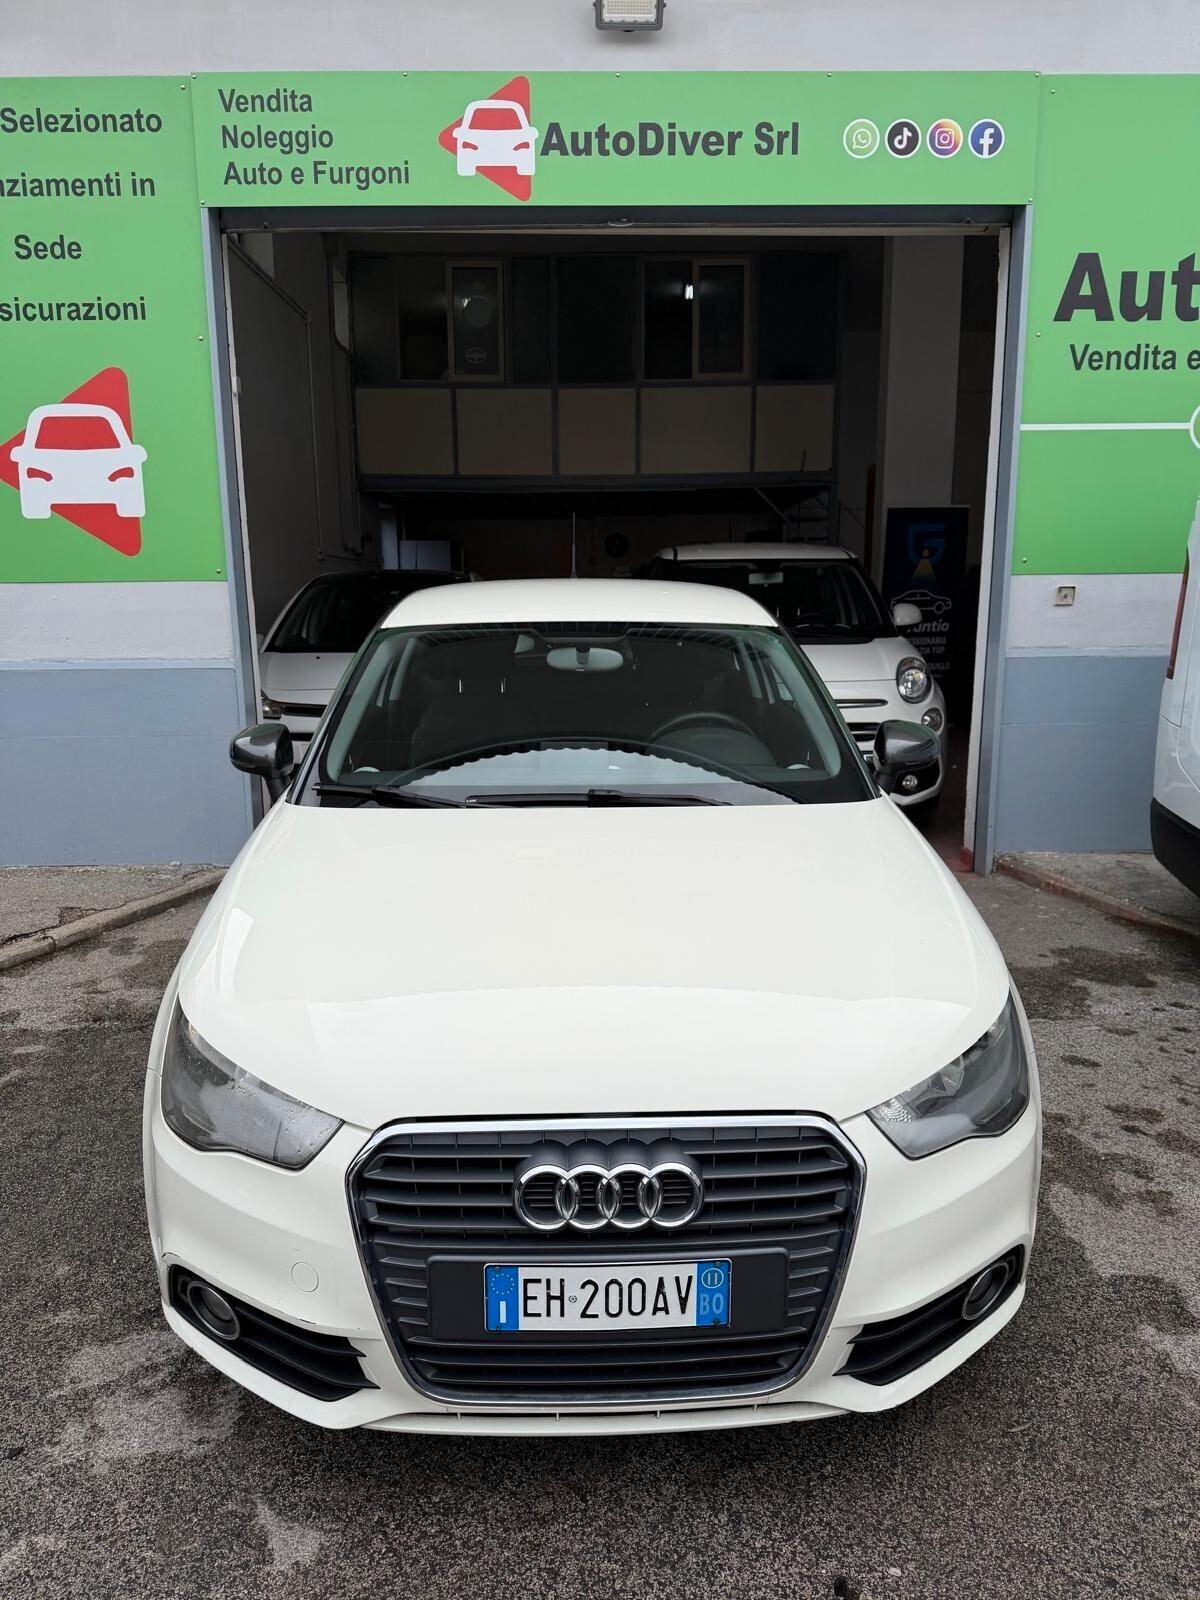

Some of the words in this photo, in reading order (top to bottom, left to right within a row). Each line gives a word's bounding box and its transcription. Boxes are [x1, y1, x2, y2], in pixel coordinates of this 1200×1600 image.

[217, 88, 312, 112] Vendita
[0, 107, 163, 134] Selezionato
[221, 123, 334, 155] Noleggio
[539, 122, 744, 157] AutoDiver
[754, 121, 799, 156] Srl
[130, 171, 156, 197] in
[223, 161, 283, 186] Auto
[290, 166, 305, 185] e
[313, 160, 410, 191] Furgoni
[14, 234, 82, 261] Sede
[1052, 252, 1200, 323] Aut
[1069, 343, 1177, 371] Vendita
[699, 1292, 724, 1316] BO
